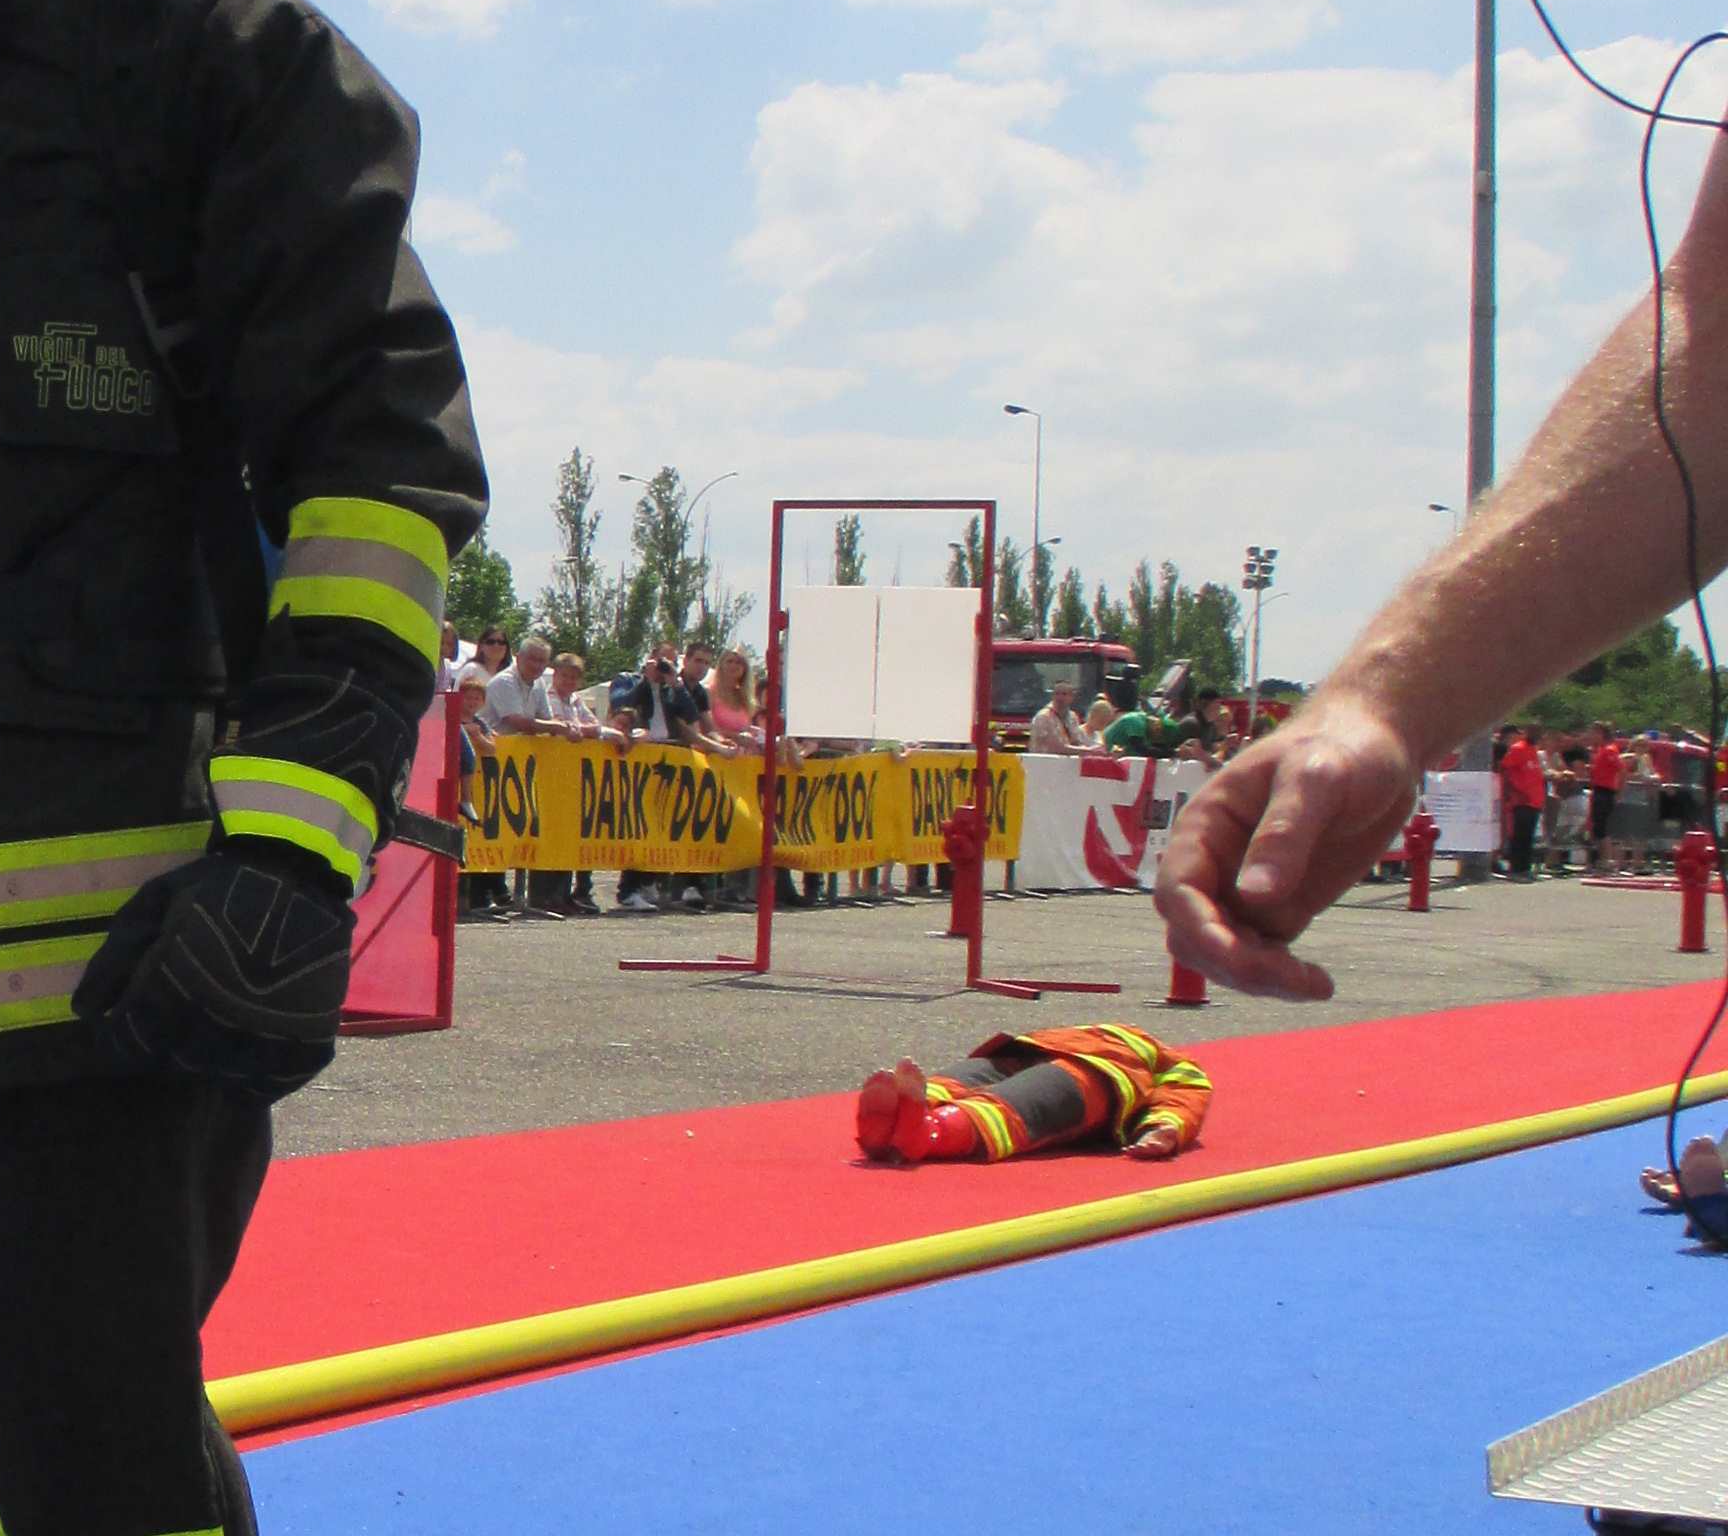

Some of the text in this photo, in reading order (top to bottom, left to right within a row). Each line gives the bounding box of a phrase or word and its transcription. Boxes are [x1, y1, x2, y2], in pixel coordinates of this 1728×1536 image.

[13, 335, 130, 367] VIGILI DEL
[34, 362, 153, 416] FUOCO
[580, 757, 649, 841] DARK
